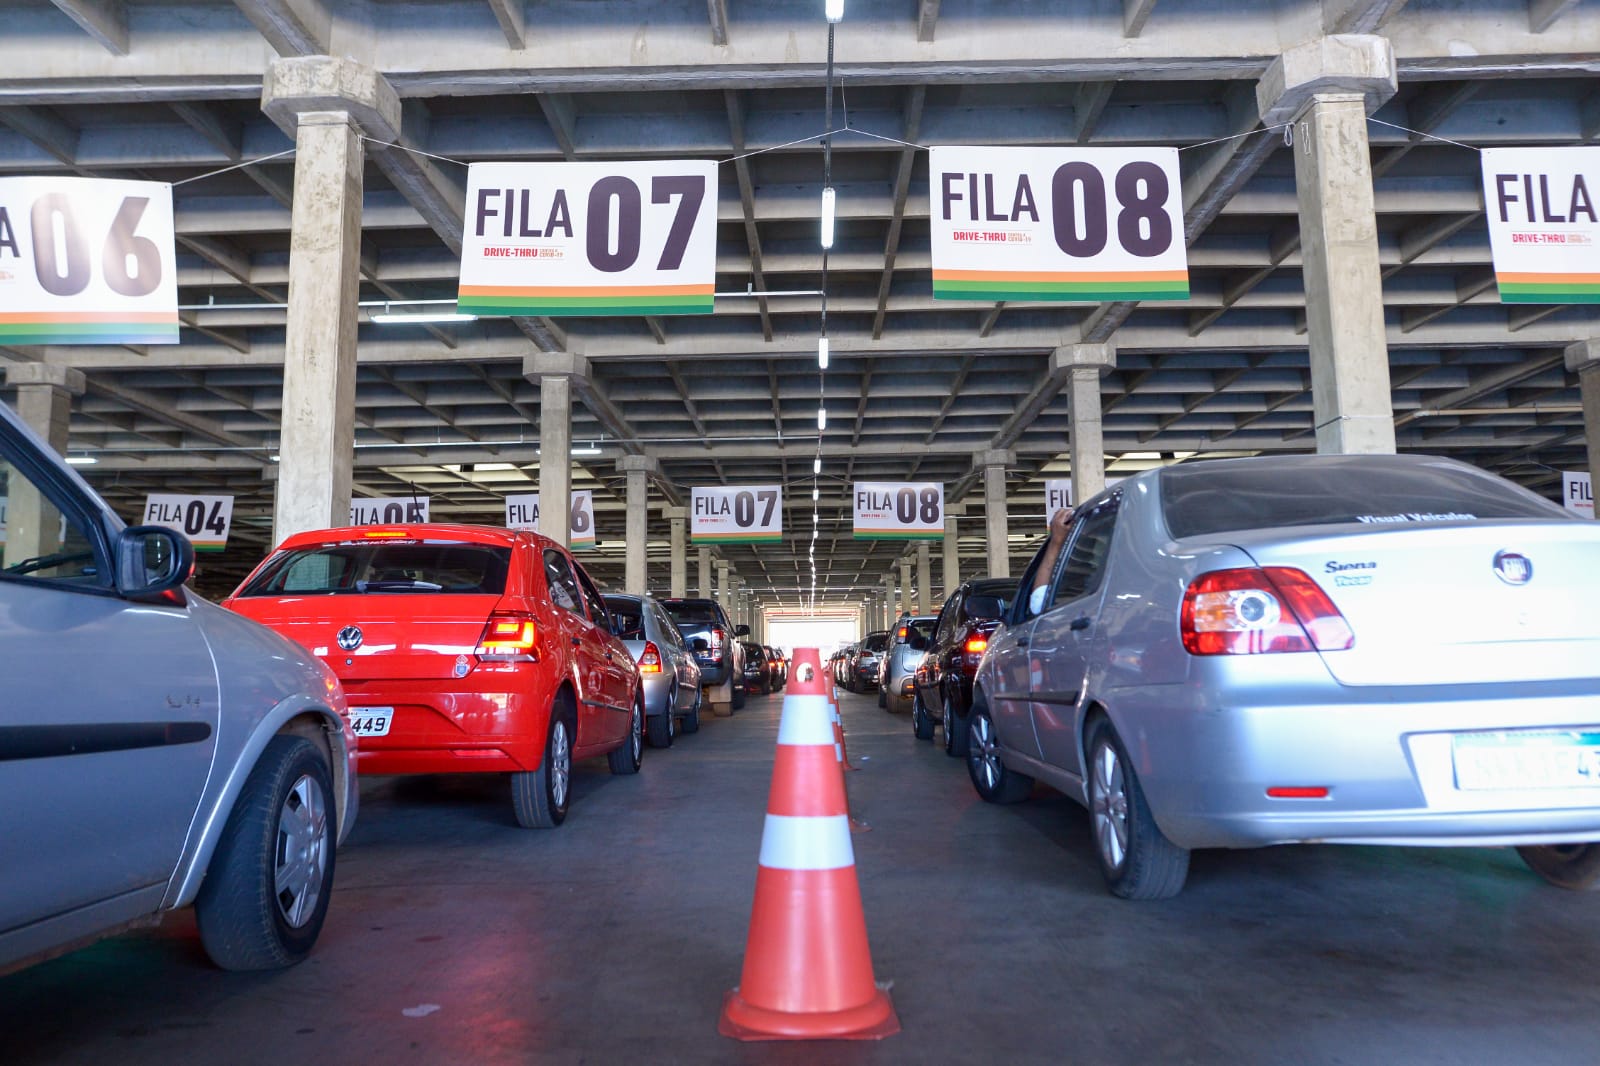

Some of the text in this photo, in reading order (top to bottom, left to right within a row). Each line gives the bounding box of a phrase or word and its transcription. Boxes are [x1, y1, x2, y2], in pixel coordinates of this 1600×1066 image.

[942, 161, 1172, 258] FILA 08
[1496, 174, 1598, 223] FILA
[475, 175, 706, 273] FILA 07
[953, 231, 1007, 242] DRIVE-THRU
[30, 192, 162, 297] 06
[1512, 233, 1566, 243] DRIVE-THRU
[484, 247, 538, 257] DRIVE-THRU
[1050, 489, 1073, 508] FIL
[1570, 481, 1594, 500] FIL
[148, 500, 226, 536] FILA 04
[571, 496, 589, 533] 6
[695, 490, 778, 528] FILA 07
[857, 487, 940, 524] FILA 08
[1356, 512, 1477, 523] Visual Veiculos
[1324, 560, 1377, 573] Siena
[351, 717, 386, 733] 449
